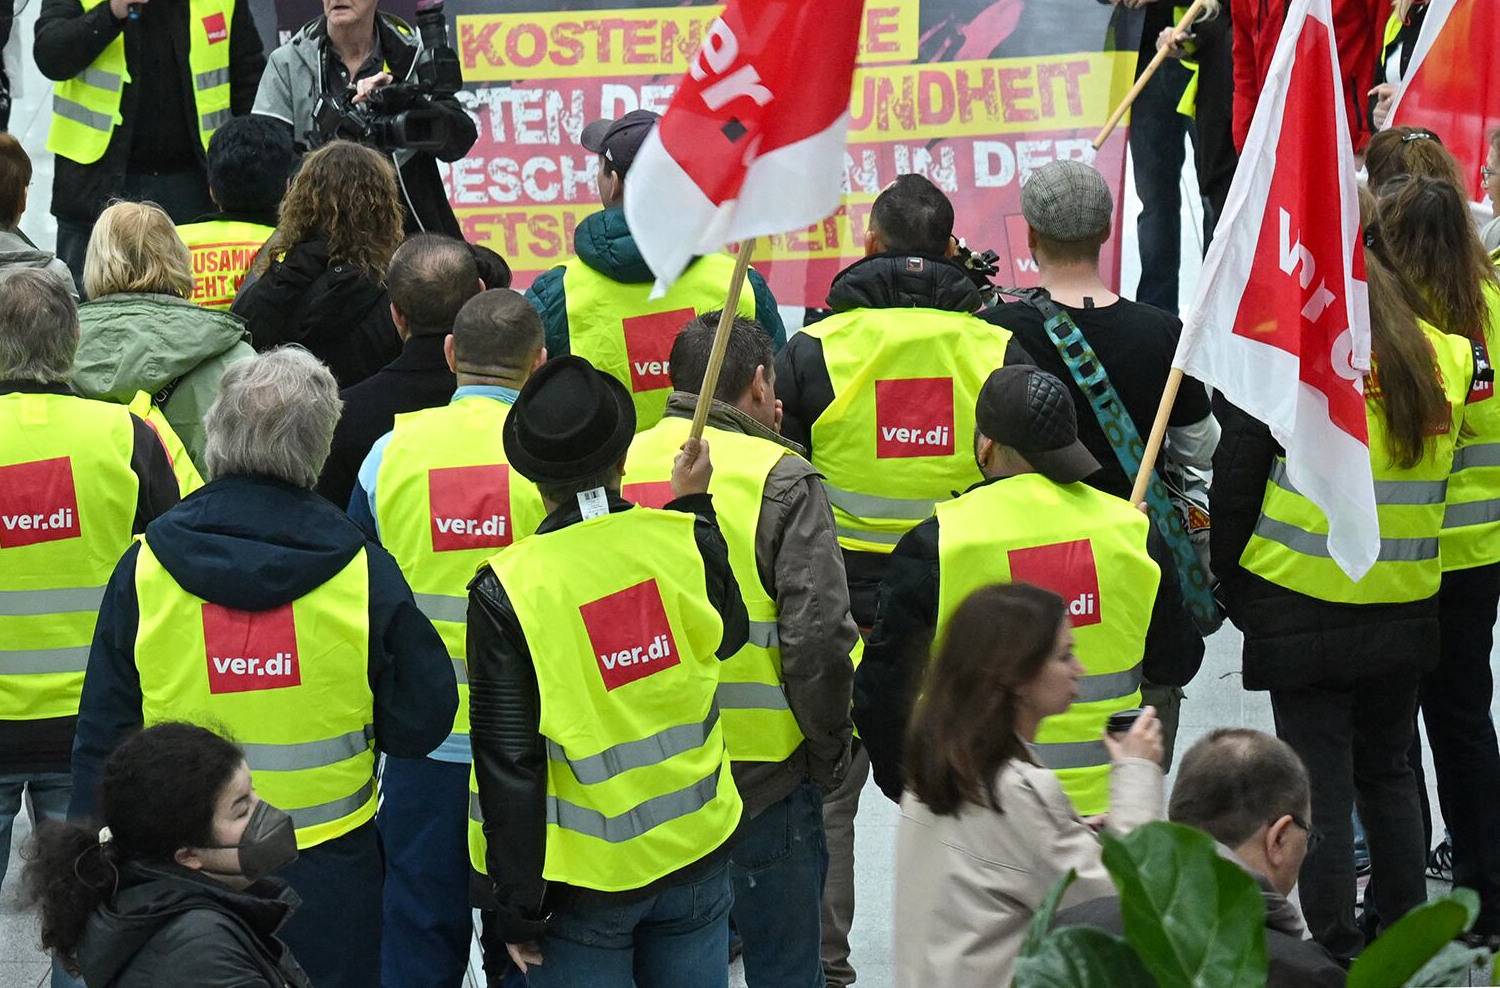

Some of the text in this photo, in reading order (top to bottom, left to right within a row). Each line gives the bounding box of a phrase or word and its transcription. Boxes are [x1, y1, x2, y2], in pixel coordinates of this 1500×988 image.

[881, 425, 949, 446] ver.di
[2, 508, 72, 530] ver.di
[435, 515, 505, 536] ver.di
[601, 634, 670, 670] ver.di
[213, 653, 291, 676] ver.di
